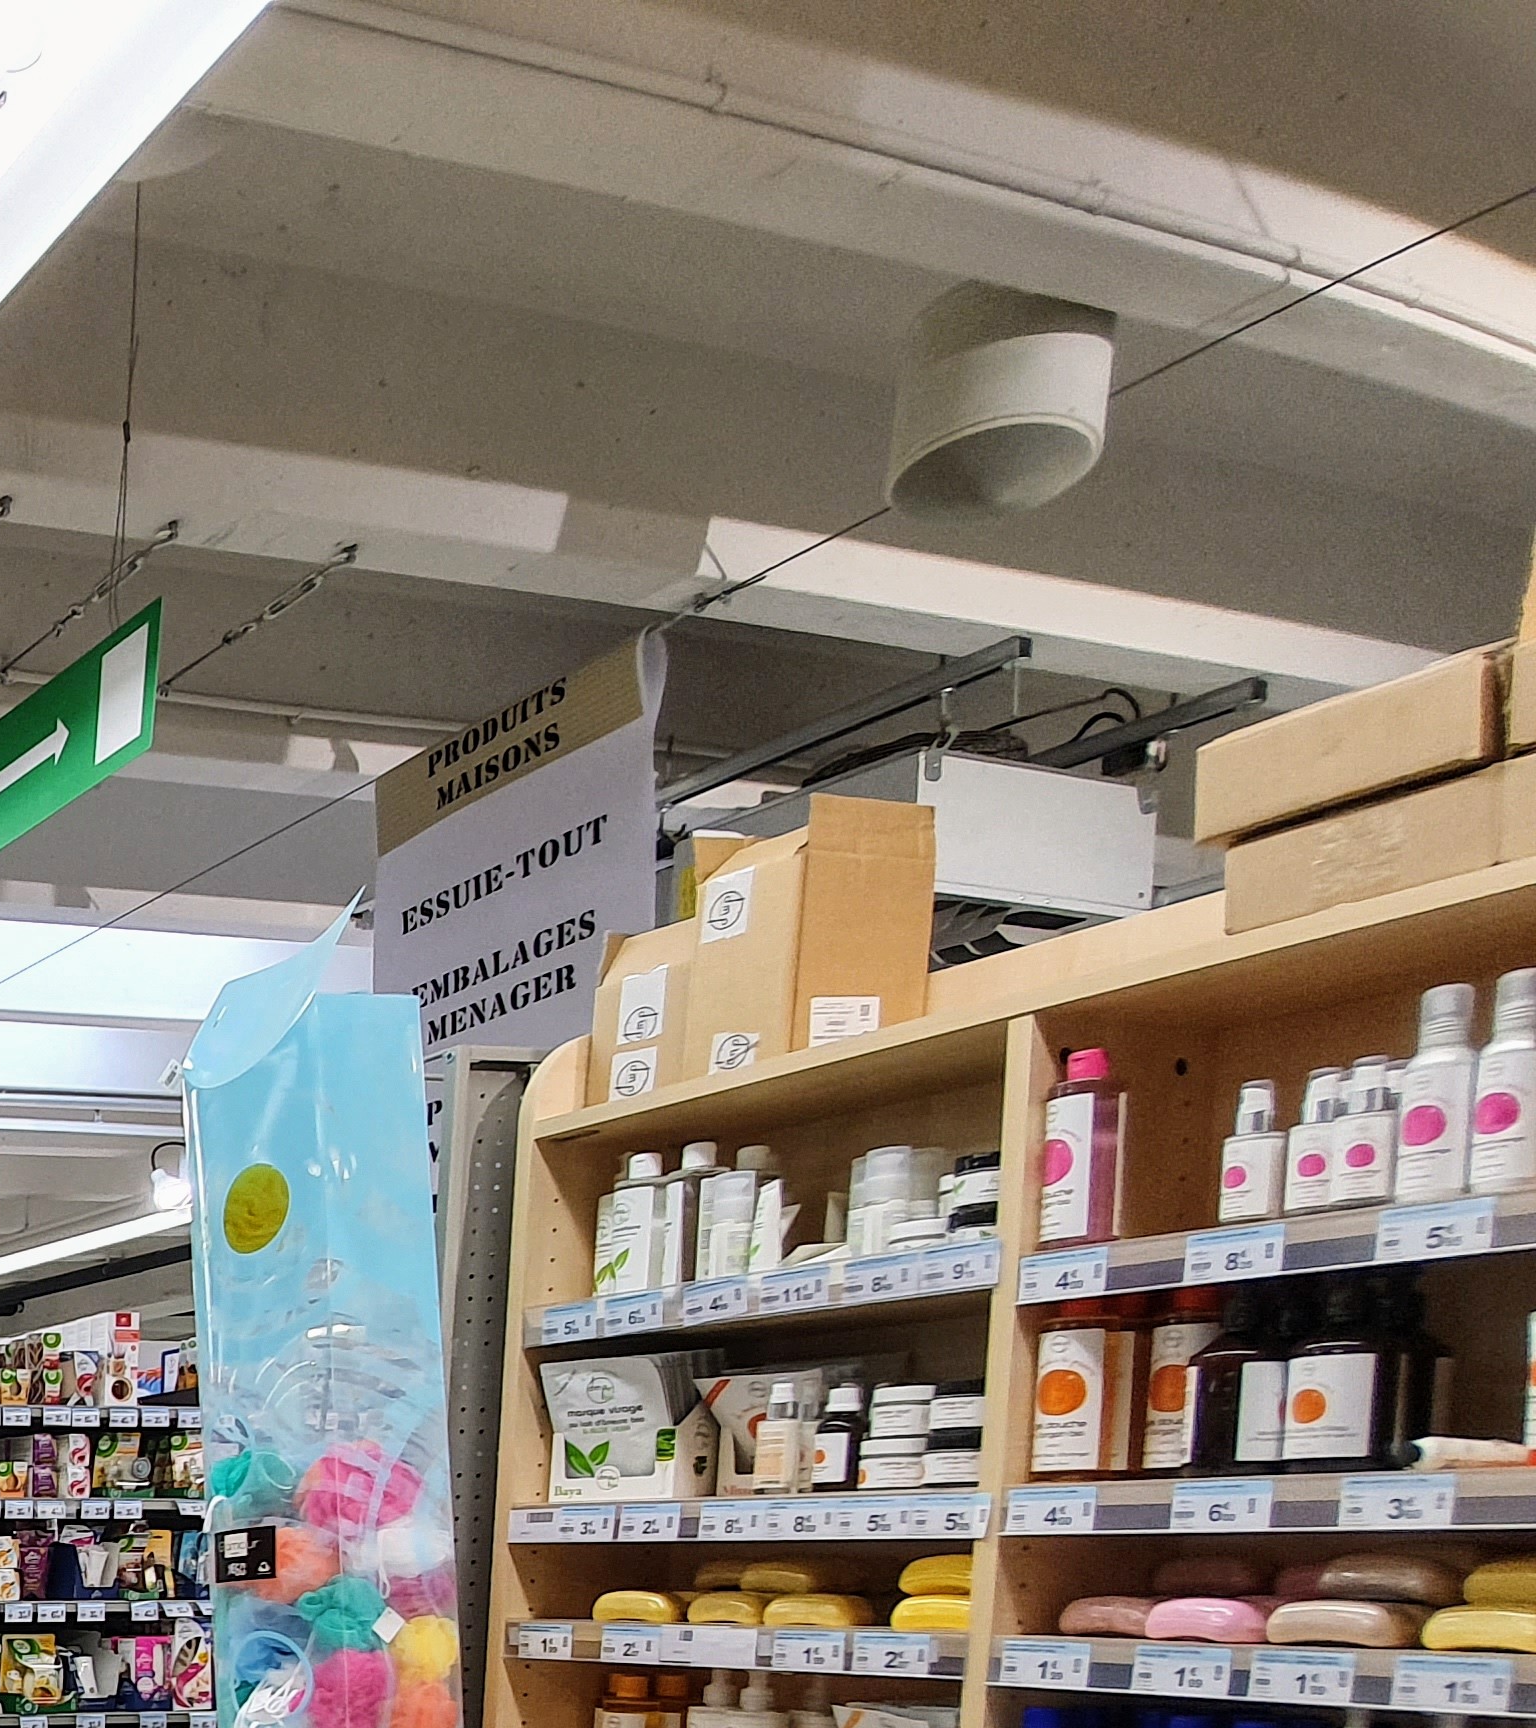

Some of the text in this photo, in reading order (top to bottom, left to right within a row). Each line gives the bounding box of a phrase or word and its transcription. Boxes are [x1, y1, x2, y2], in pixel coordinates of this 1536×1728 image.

[427, 677, 567, 778] PRODUITS
[436, 722, 561, 810] MAISONS
[401, 814, 608, 936] ESSUIE-TOUT
[411, 909, 597, 1008] EMBALAGES
[427, 963, 578, 1045] MENAGER
